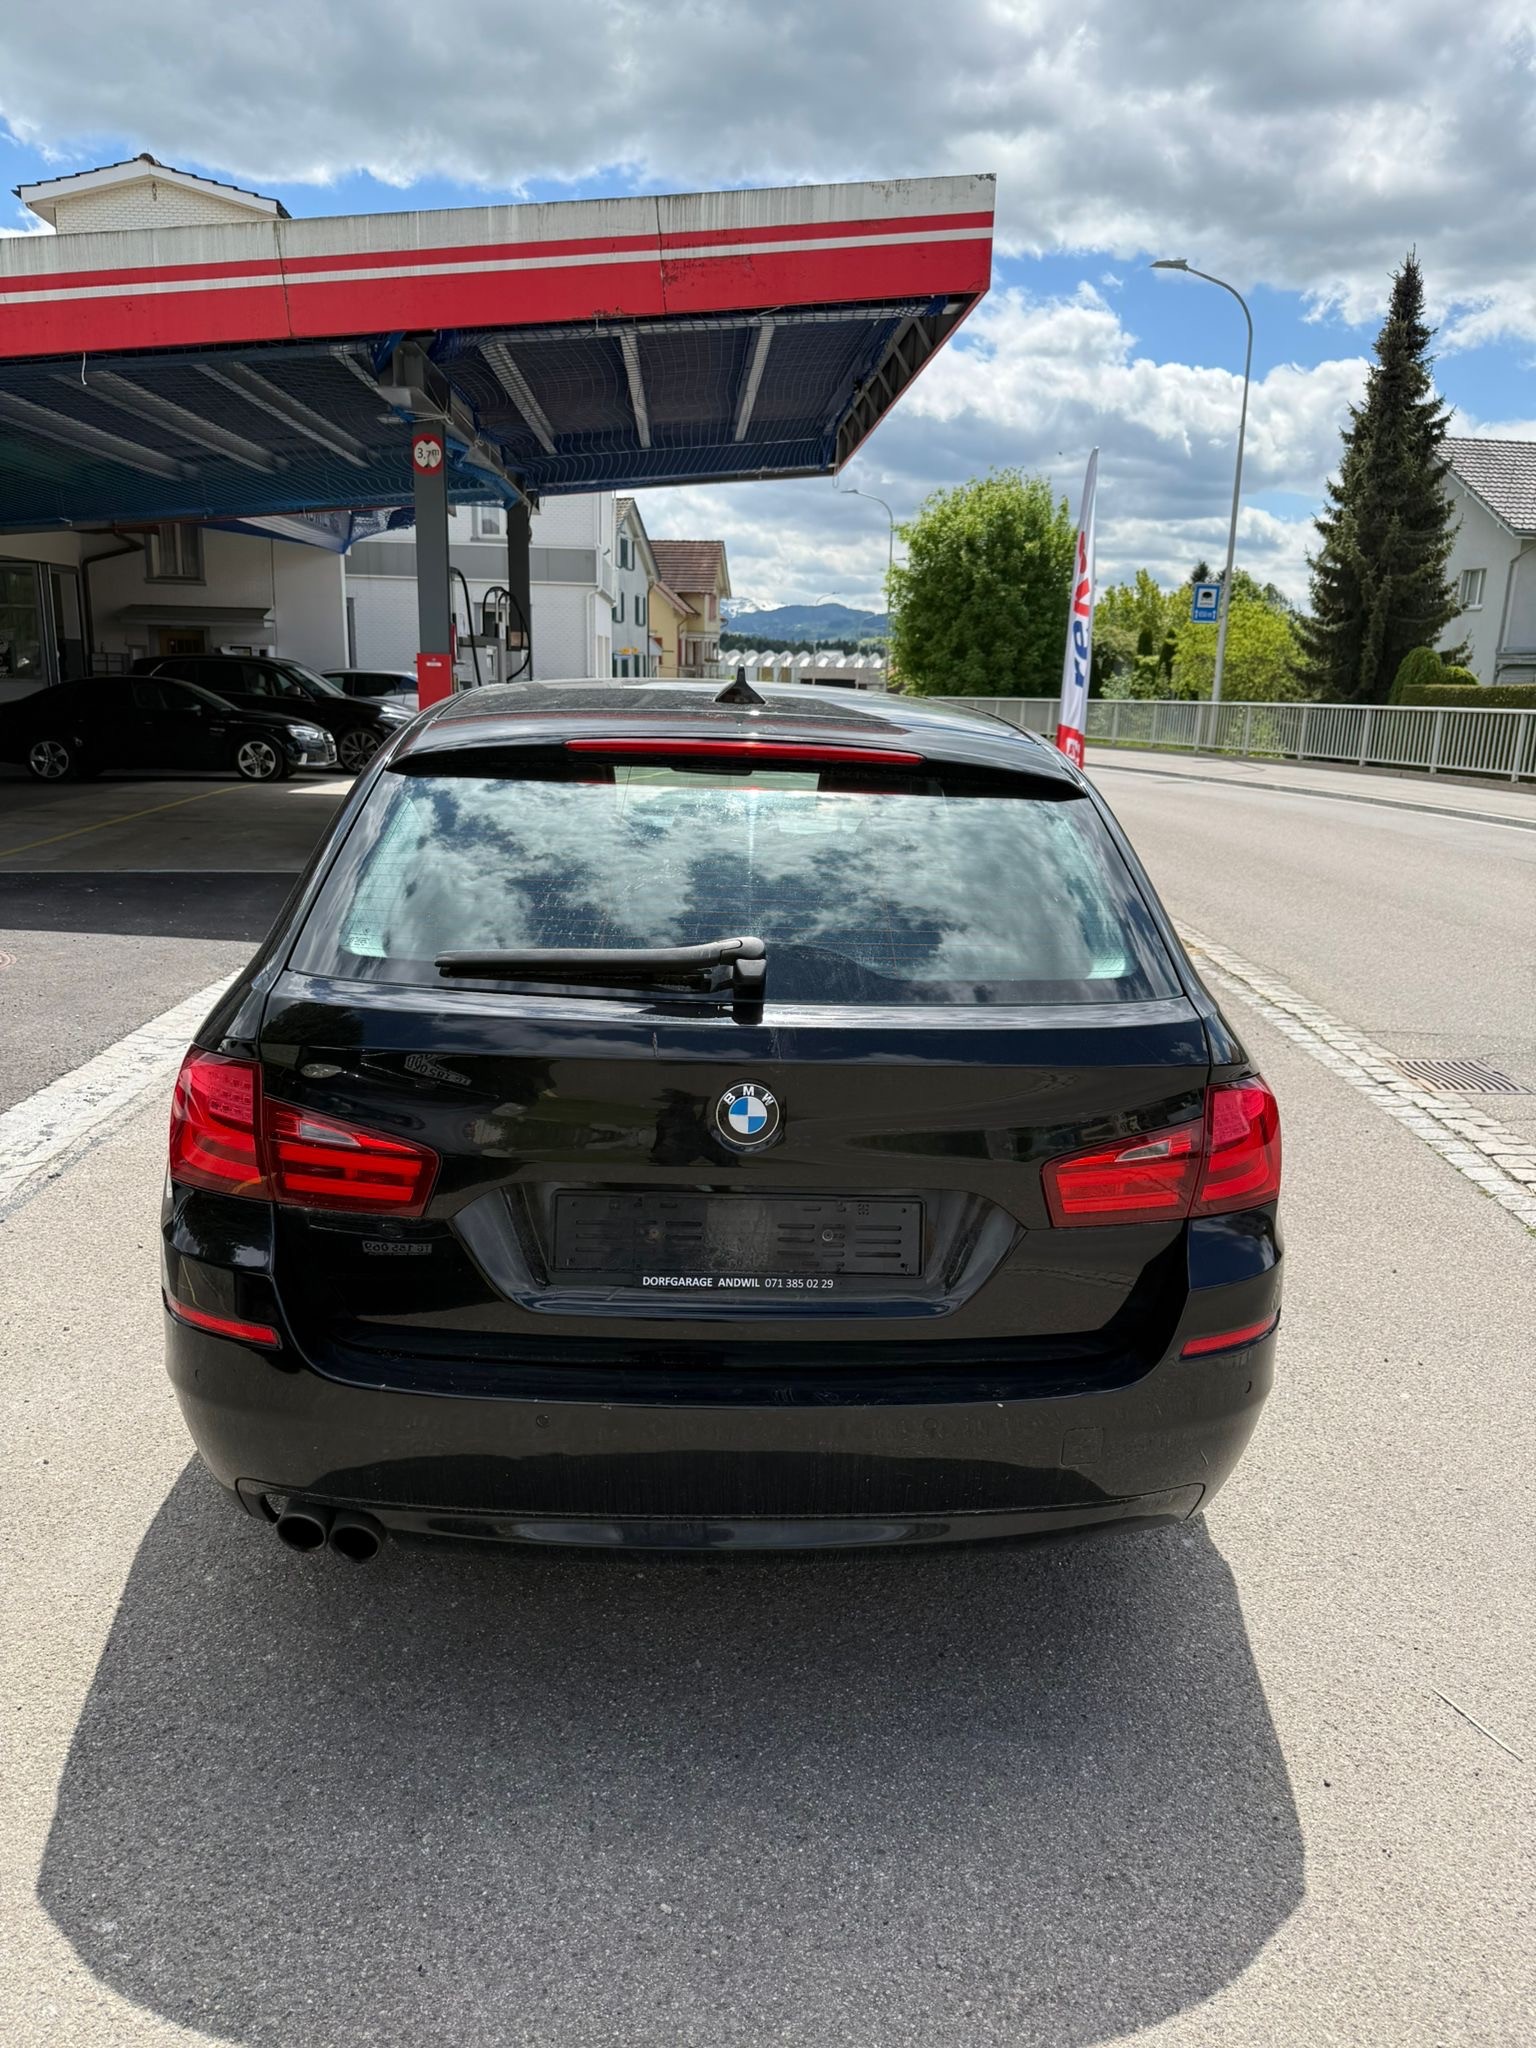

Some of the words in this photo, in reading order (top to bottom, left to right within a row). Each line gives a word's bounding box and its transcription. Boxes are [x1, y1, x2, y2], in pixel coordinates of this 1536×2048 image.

[723, 1085, 775, 1106] BMW
[642, 1276, 713, 1287] DORFGARAGE
[718, 1277, 760, 1288] ANDWIL
[764, 1278, 783, 1288] 071
[786, 1278, 804, 1289] 385
[806, 1279, 819, 1289] 02
[821, 1279, 834, 1289] 29
